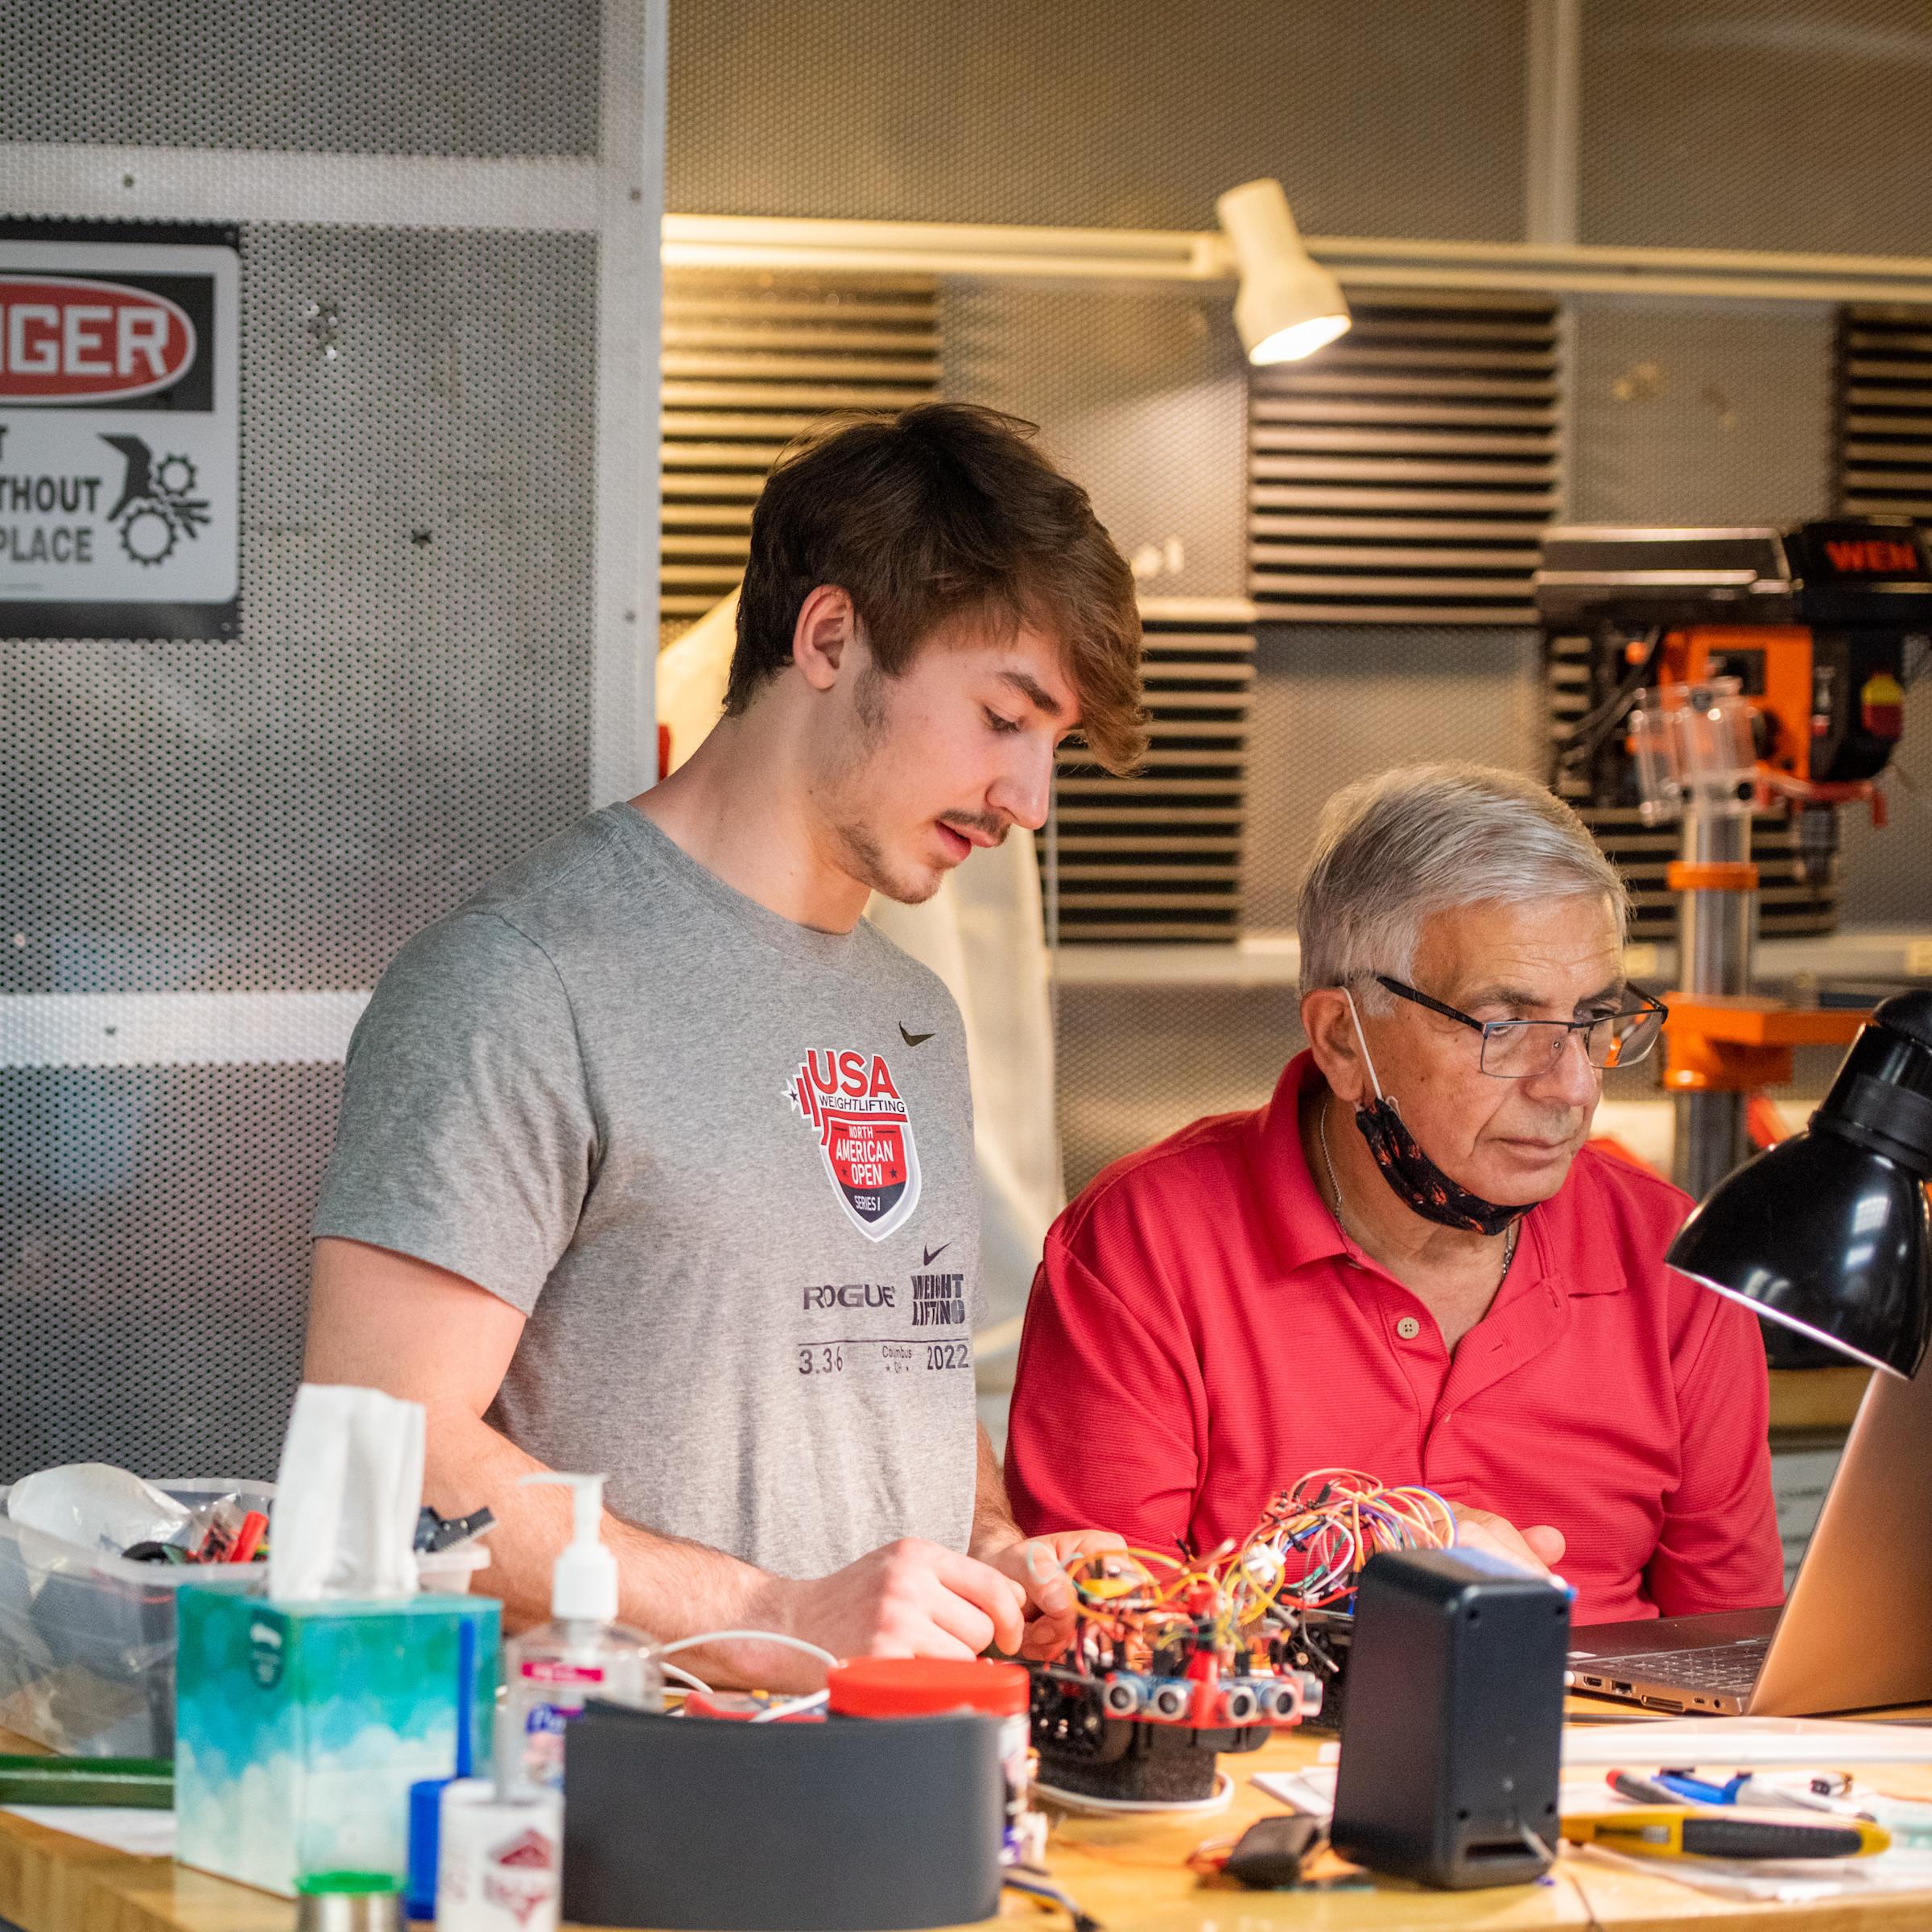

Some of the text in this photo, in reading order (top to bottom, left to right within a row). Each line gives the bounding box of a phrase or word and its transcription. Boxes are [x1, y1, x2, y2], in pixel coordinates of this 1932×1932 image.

[0, 303, 169, 378] GER
[807, 1049, 901, 1100] USA
[819, 1094, 905, 1113] WEIGHTLIFTING
[848, 1125, 873, 1139] NORTH
[836, 1138, 894, 1162] AMERICAN
[851, 1163, 882, 1185] OPEN
[854, 1195, 877, 1211] SERIES
[803, 1284, 895, 1310] ROGUE
[910, 1274, 964, 1299] WEIGHT
[911, 1299, 965, 1326] LIFTING
[882, 1345, 913, 1359] Colmbus
[927, 1344, 968, 1370] 2022
